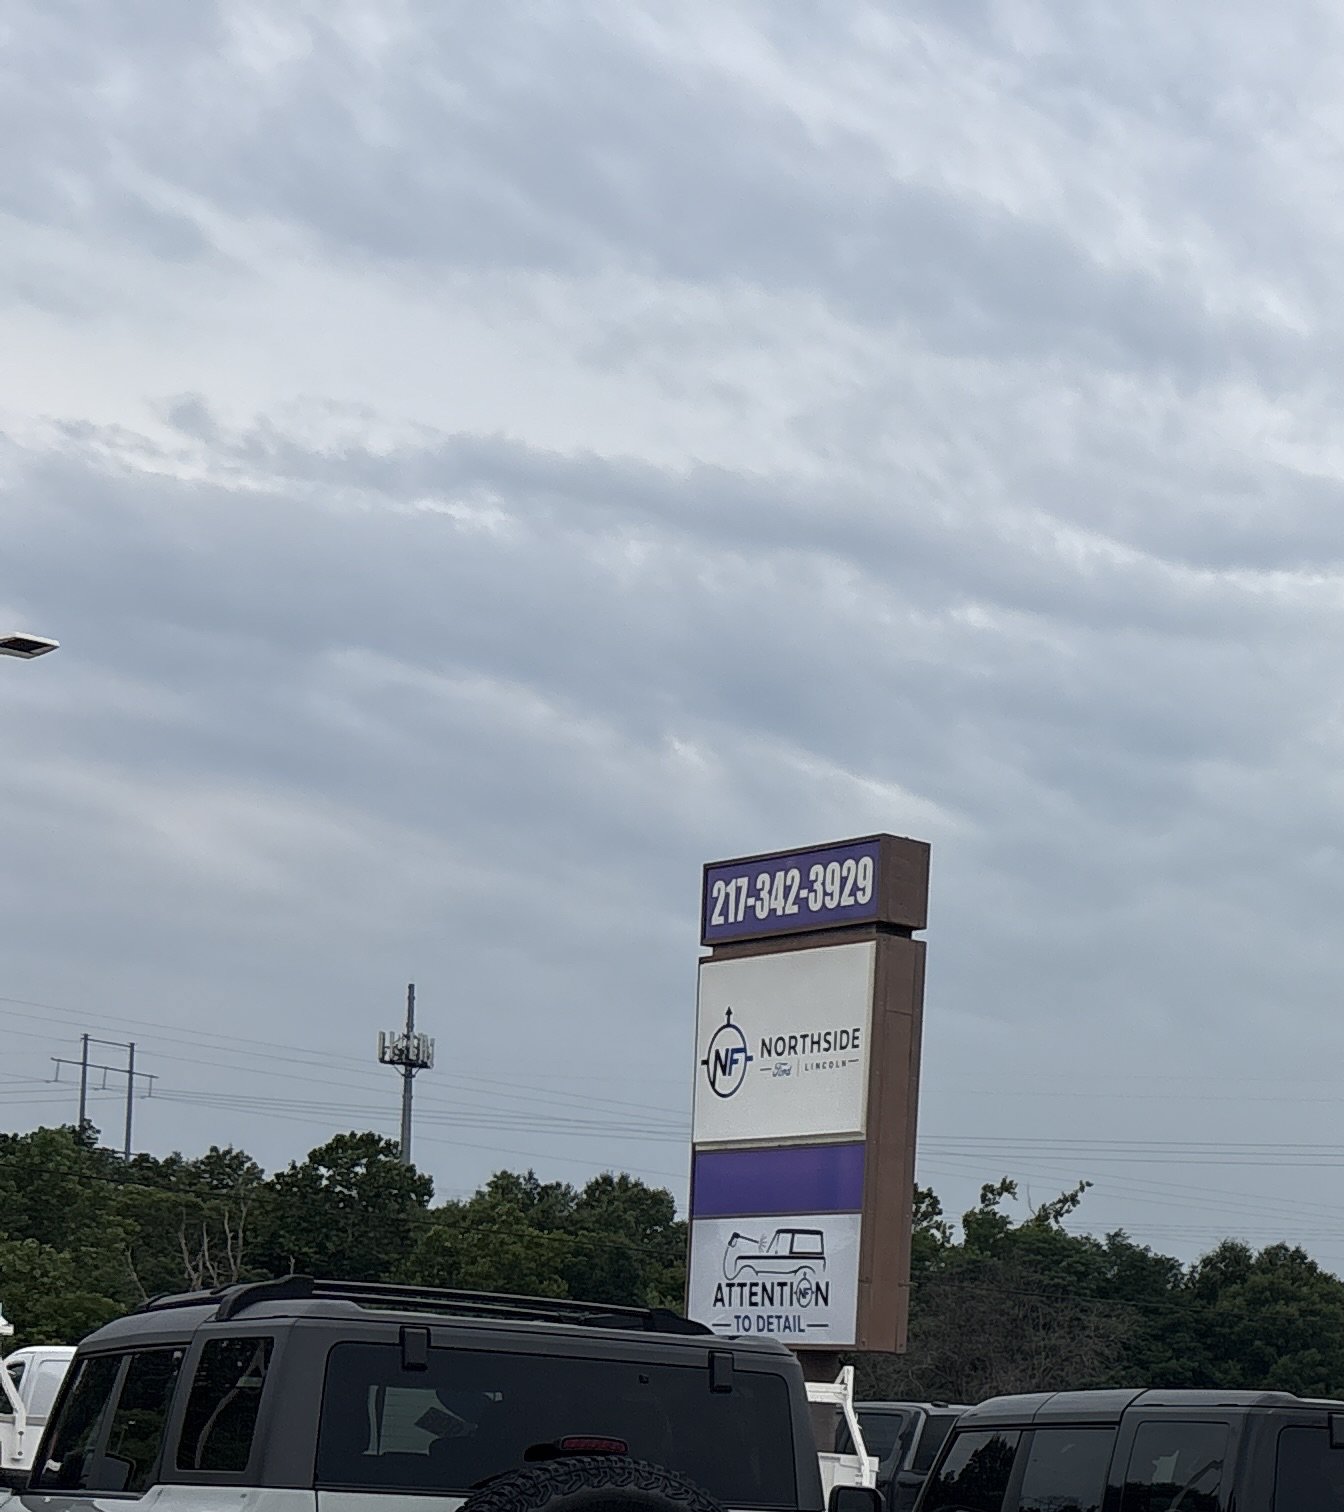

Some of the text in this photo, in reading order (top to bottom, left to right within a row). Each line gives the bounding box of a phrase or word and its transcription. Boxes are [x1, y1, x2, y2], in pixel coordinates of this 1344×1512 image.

[711, 856, 873, 926] 217-342-3929
[760, 1028, 861, 1058] NORTHSIDE
[712, 1048, 747, 1085] NF
[772, 1060, 847, 1078] Ford LINCOLN
[712, 1281, 830, 1308] ATTENTION
[734, 1315, 806, 1332] TO DETAIL
